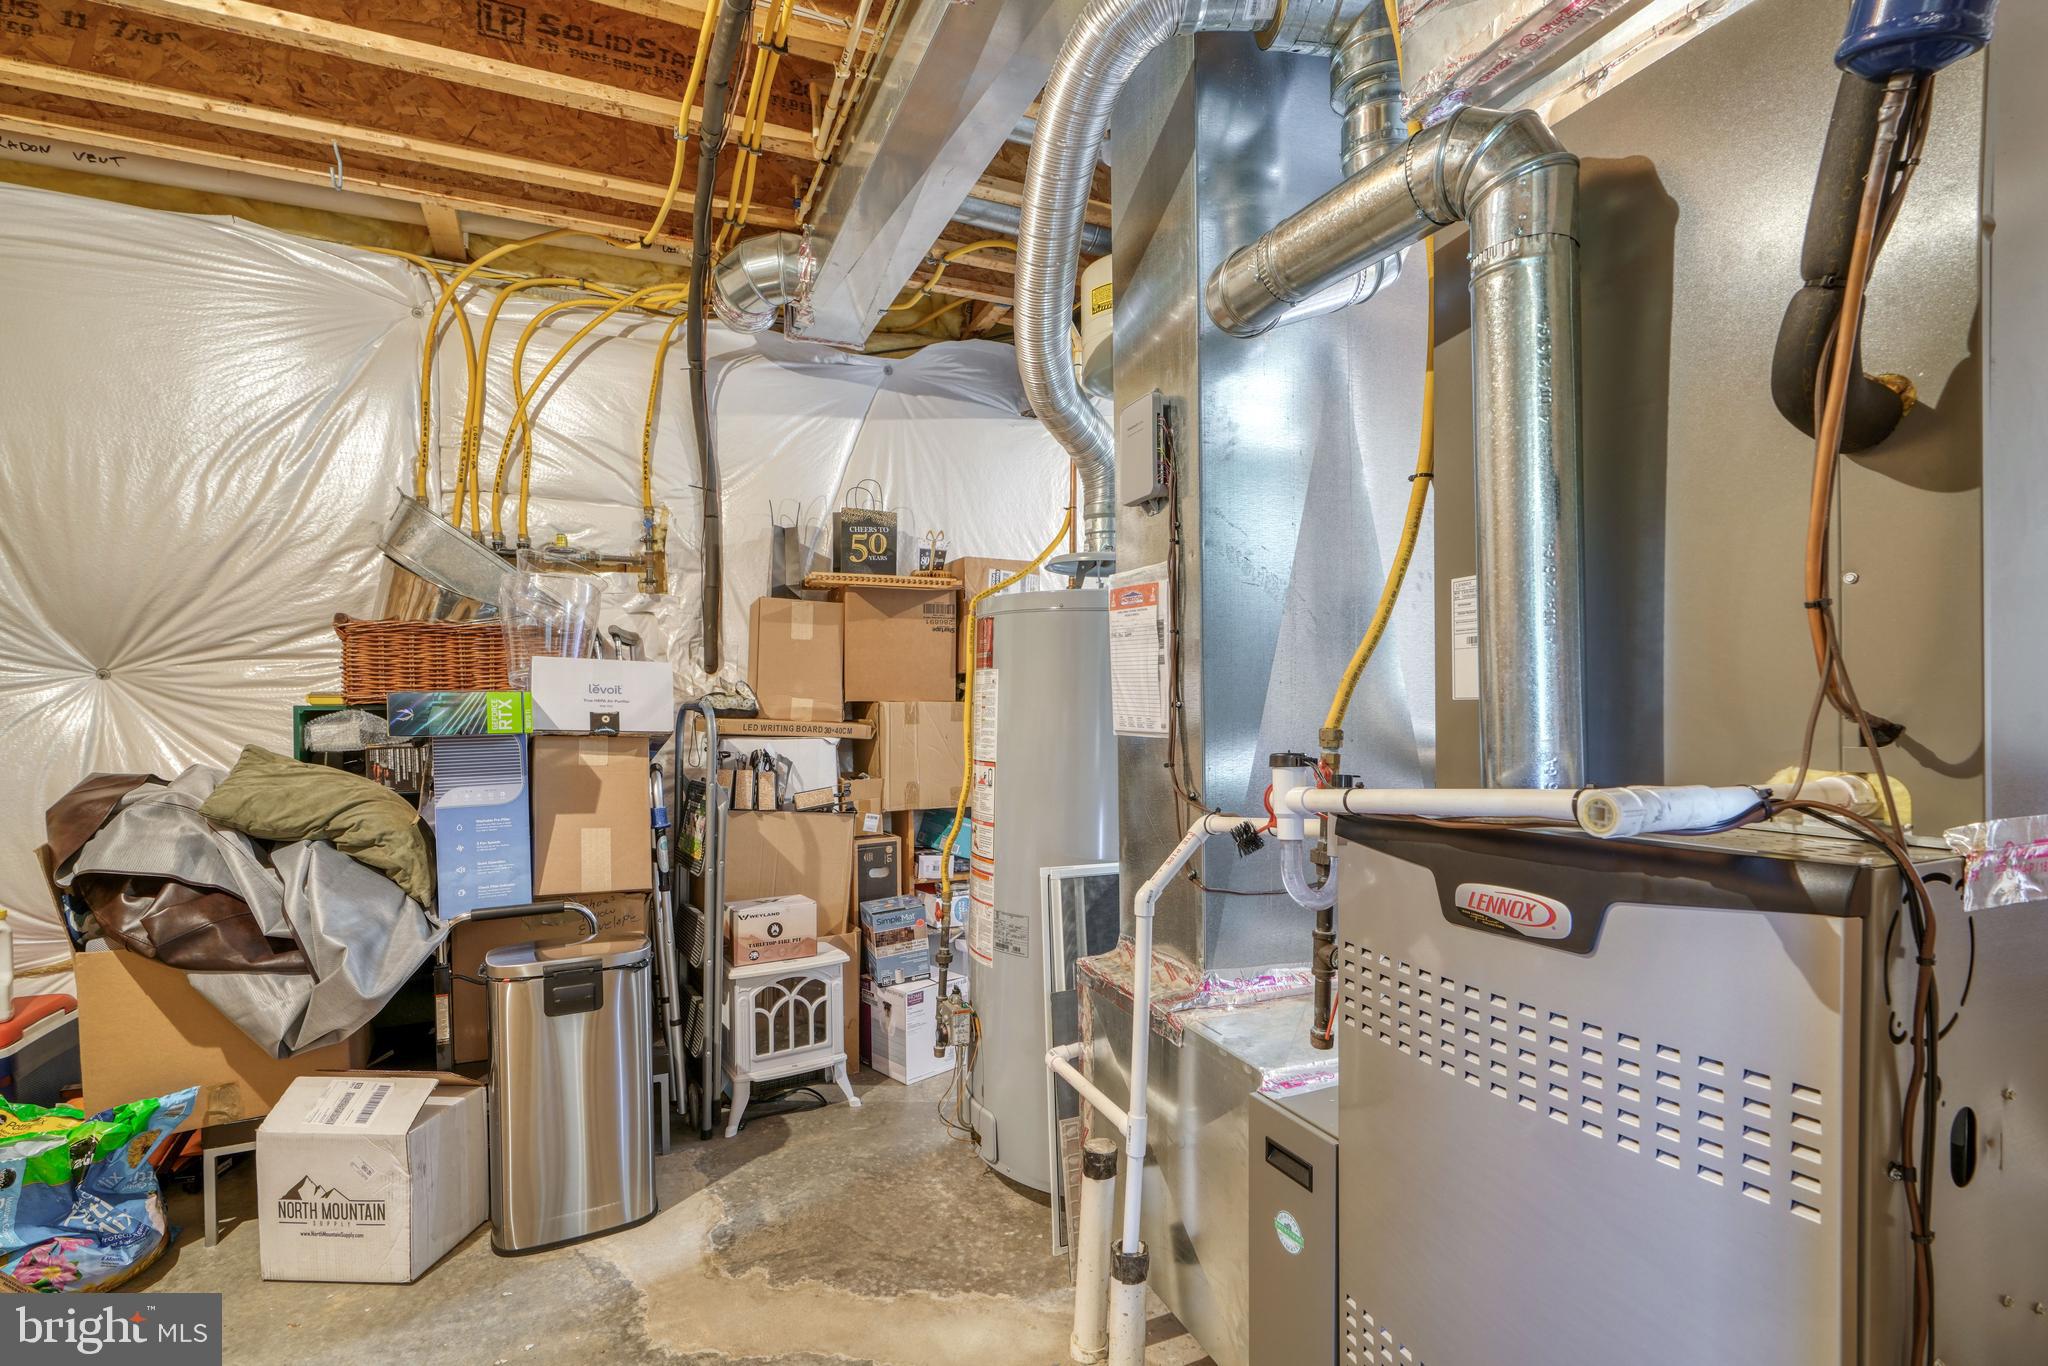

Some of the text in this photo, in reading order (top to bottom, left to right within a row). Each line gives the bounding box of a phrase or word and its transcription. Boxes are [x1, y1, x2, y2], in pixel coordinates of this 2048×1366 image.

[849, 532, 888, 563] 50
[498, 698, 513, 731] RTX
[742, 723, 759, 732] LED
[760, 723, 795, 733] WRITING
[795, 724, 823, 734] BOARD
[1467, 891, 1538, 922] LENNOX
[749, 911, 781, 919] WEYLAND
[876, 912, 916, 926] SimpleMat
[748, 940, 777, 949] TABLETOP
[278, 1201, 386, 1221] NORTH MOUNTAIN
[300, 1231, 364, 1239] www.NorthMountainSupply.com
